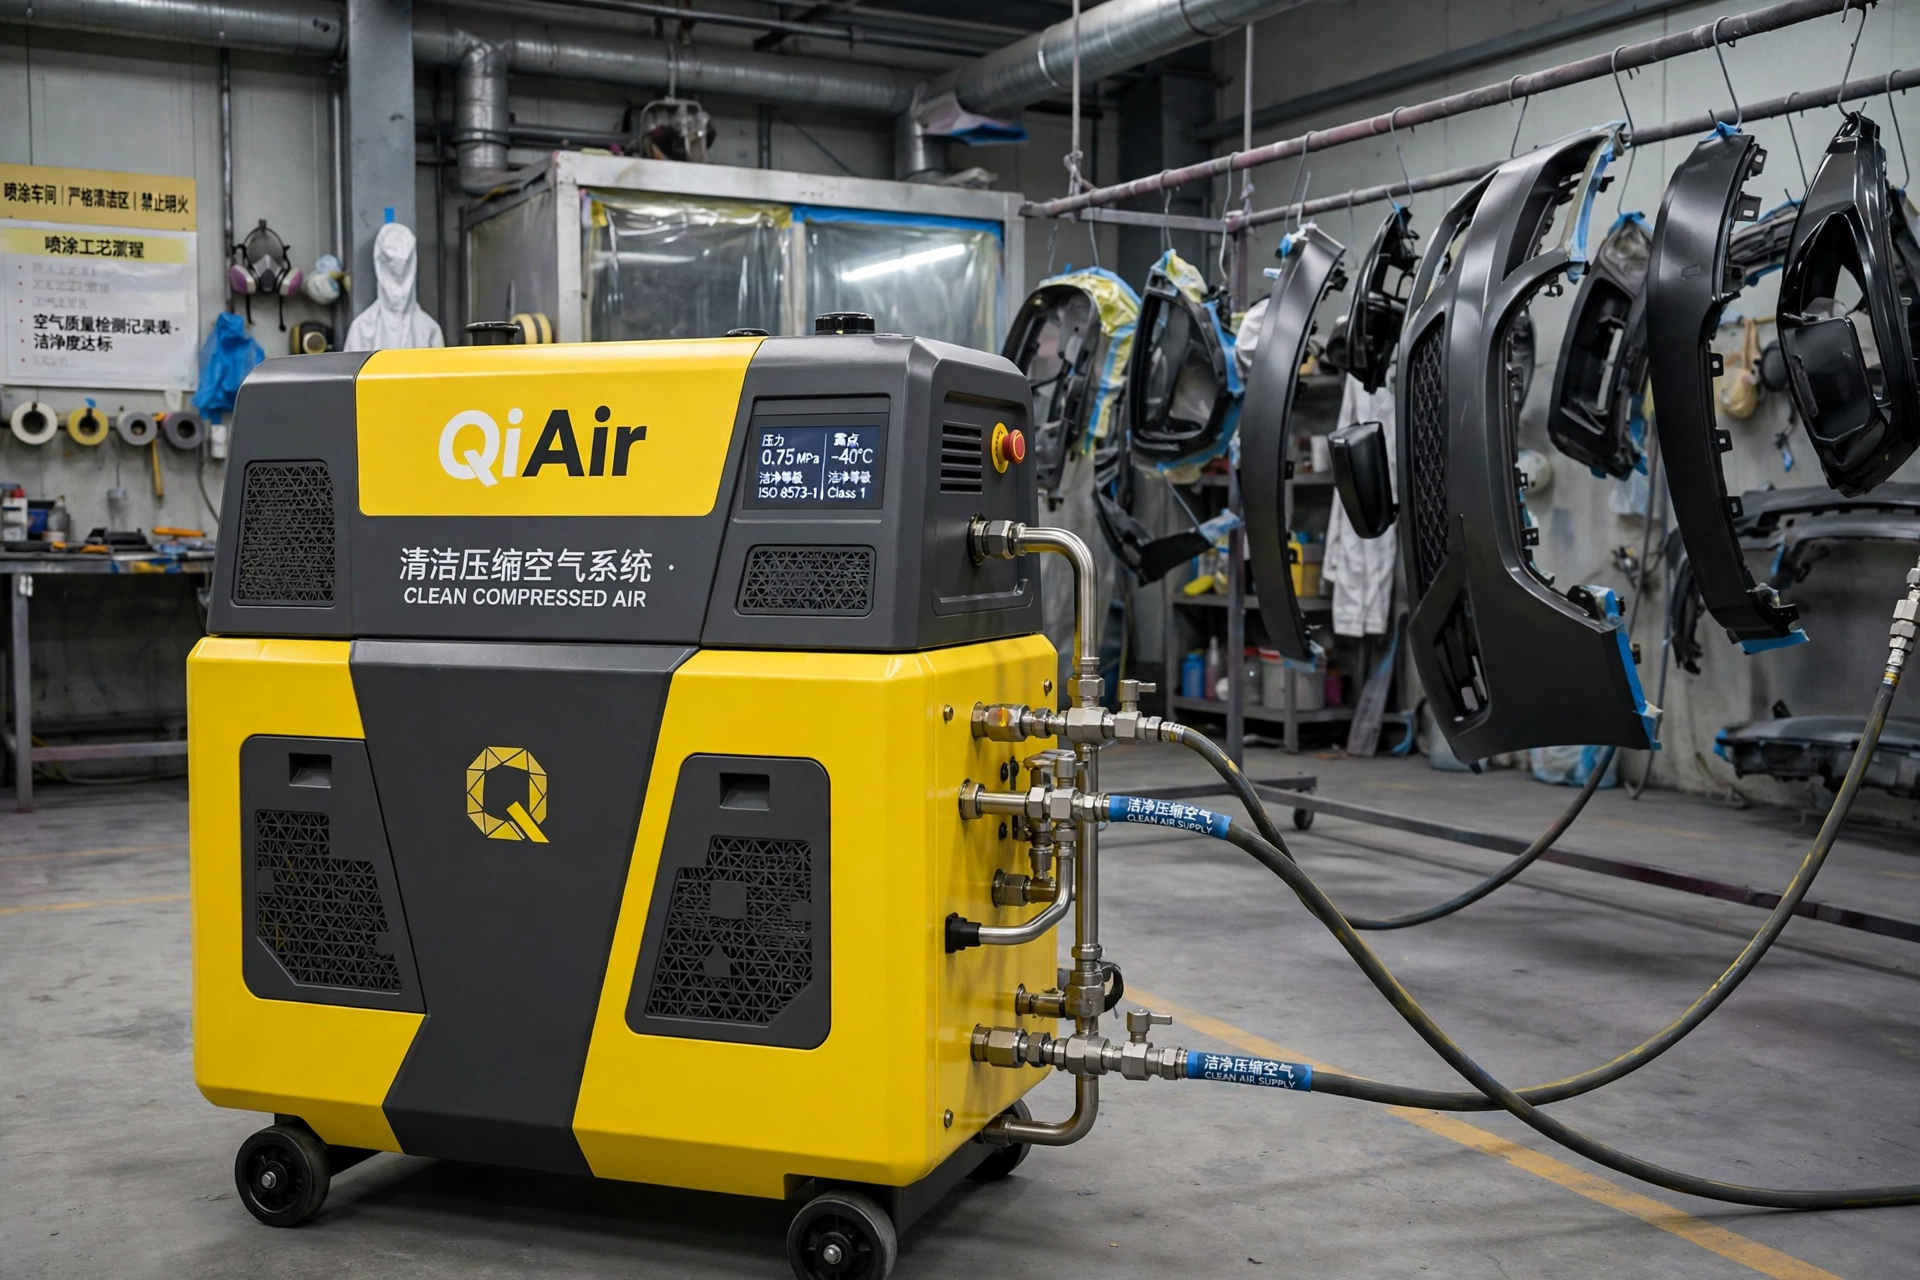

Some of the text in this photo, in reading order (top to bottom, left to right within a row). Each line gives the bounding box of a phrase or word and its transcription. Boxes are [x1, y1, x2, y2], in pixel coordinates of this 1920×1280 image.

[4, 182, 57, 205] 喷涂车间
[34, 333, 113, 352] 洁净度达标
[438, 405, 648, 488] QiAir
[761, 434, 785, 447] 压力
[761, 448, 820, 466] 0.75 MPa
[758, 486, 818, 499] ISO 8573-1
[827, 487, 866, 499] Class 1
[404, 587, 647, 608] CLEAN COMPRESSED AIR
[1127, 797, 1213, 824] 洁净压缩空气
[1127, 814, 1213, 834] CLEAN AIR SUPPLY
[1204, 1054, 1294, 1080] 洁净压缩空气
[1204, 1071, 1296, 1089] CLEAN AIR SUPPLY
